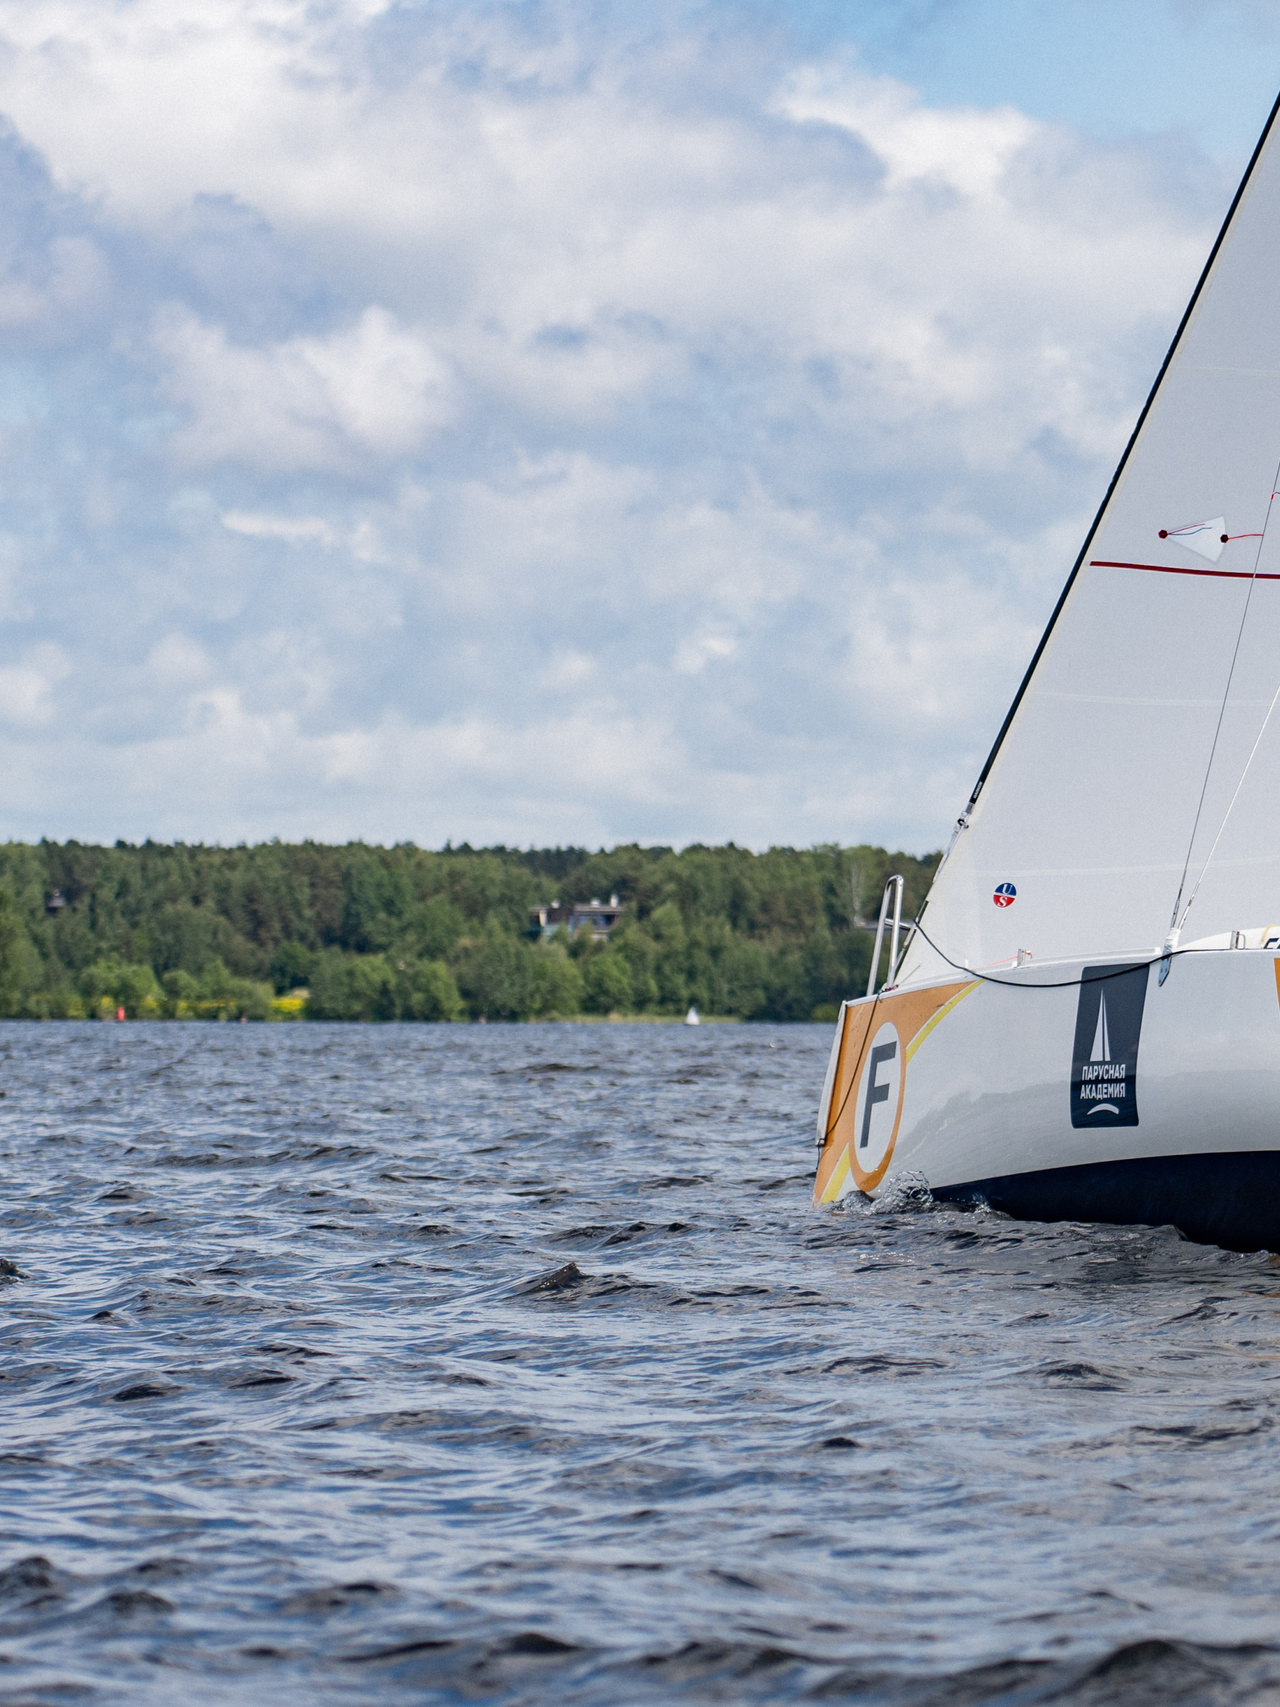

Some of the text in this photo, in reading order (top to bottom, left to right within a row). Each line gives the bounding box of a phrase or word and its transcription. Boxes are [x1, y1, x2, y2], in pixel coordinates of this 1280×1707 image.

[1082, 1064, 1126, 1081] ПАРУСНАЯ
[860, 1041, 897, 1149] F
[1080, 1083, 1126, 1100] АКАДЕМИЯ
